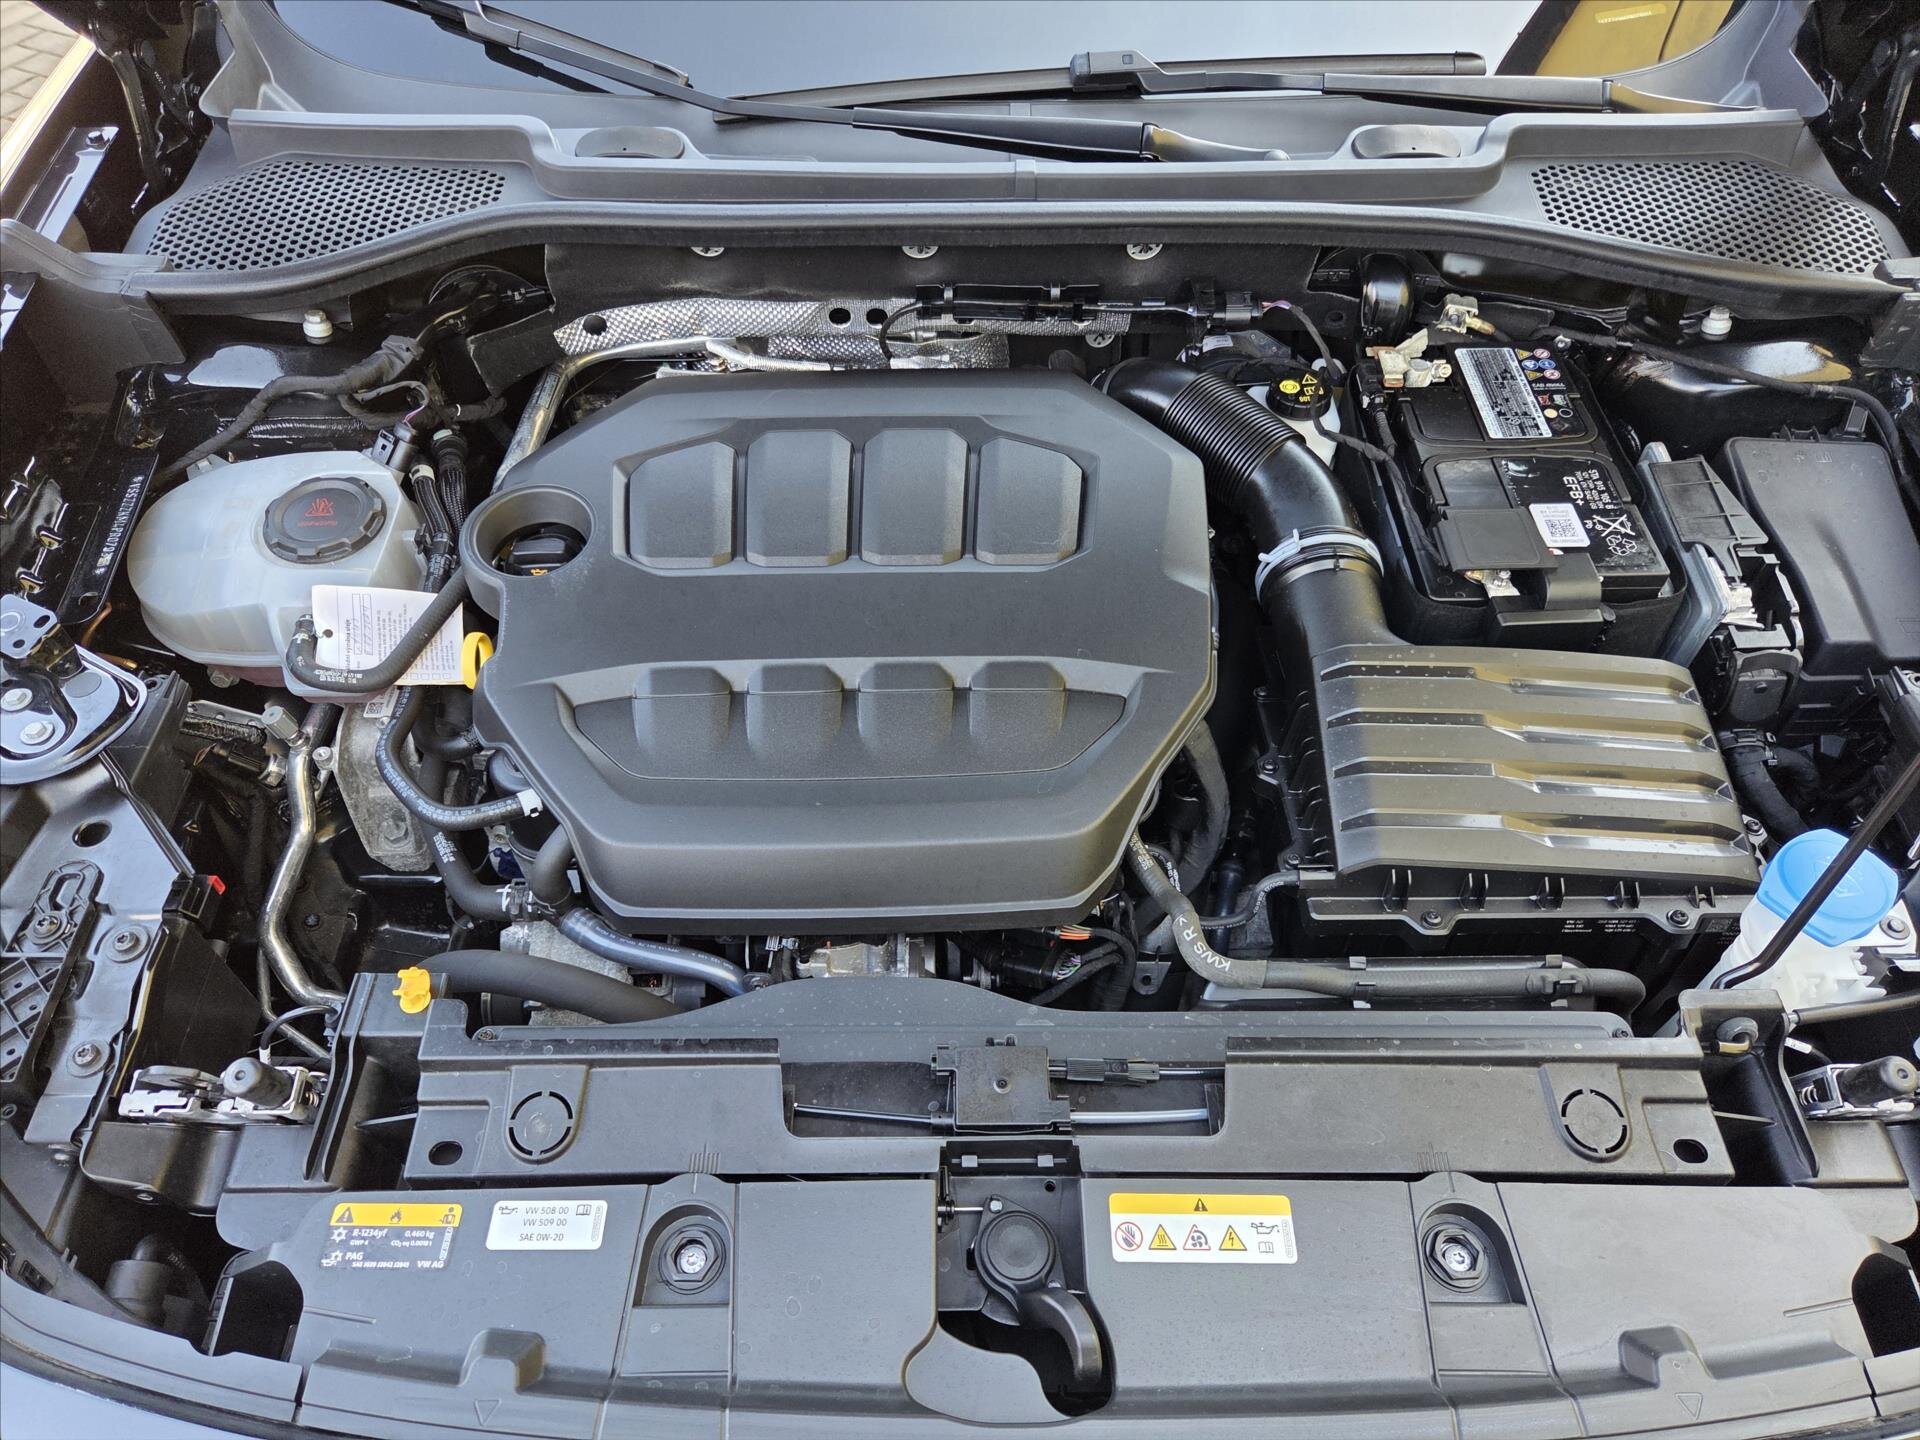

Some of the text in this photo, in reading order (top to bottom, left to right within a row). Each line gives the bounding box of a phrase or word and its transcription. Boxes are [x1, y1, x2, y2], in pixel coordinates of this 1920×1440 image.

[1562, 476, 1585, 506] EFB+
[1583, 519, 1594, 529] Pb
[1194, 942, 1231, 972] KWS
[352, 1228, 388, 1239] R-1234yf
[426, 1230, 435, 1239] kg
[519, 1233, 564, 1241] SAE 0W-20
[345, 1252, 364, 1260] PAG
